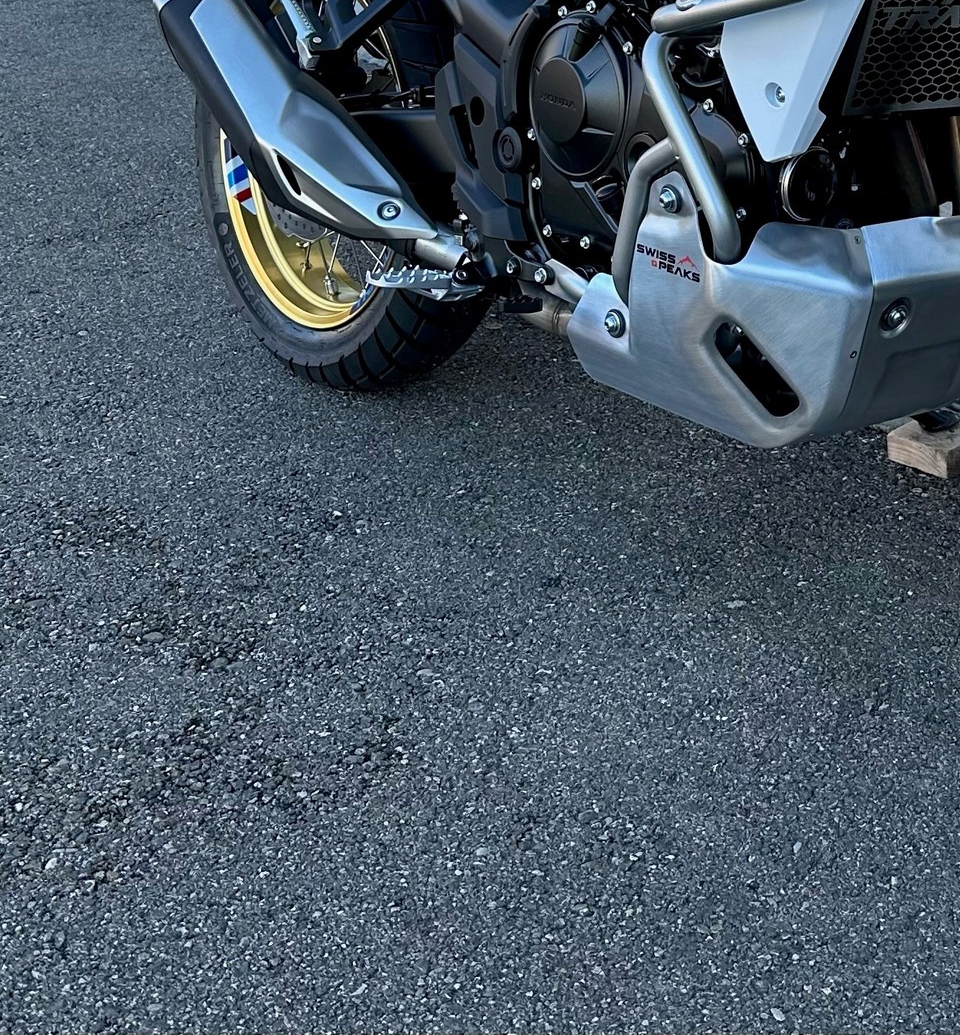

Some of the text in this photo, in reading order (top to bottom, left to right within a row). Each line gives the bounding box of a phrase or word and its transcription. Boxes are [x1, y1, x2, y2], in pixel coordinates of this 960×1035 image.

[636, 243, 676, 265] SWISS
[658, 261, 701, 283] PEAKS
[223, 241, 276, 328] METZELER
